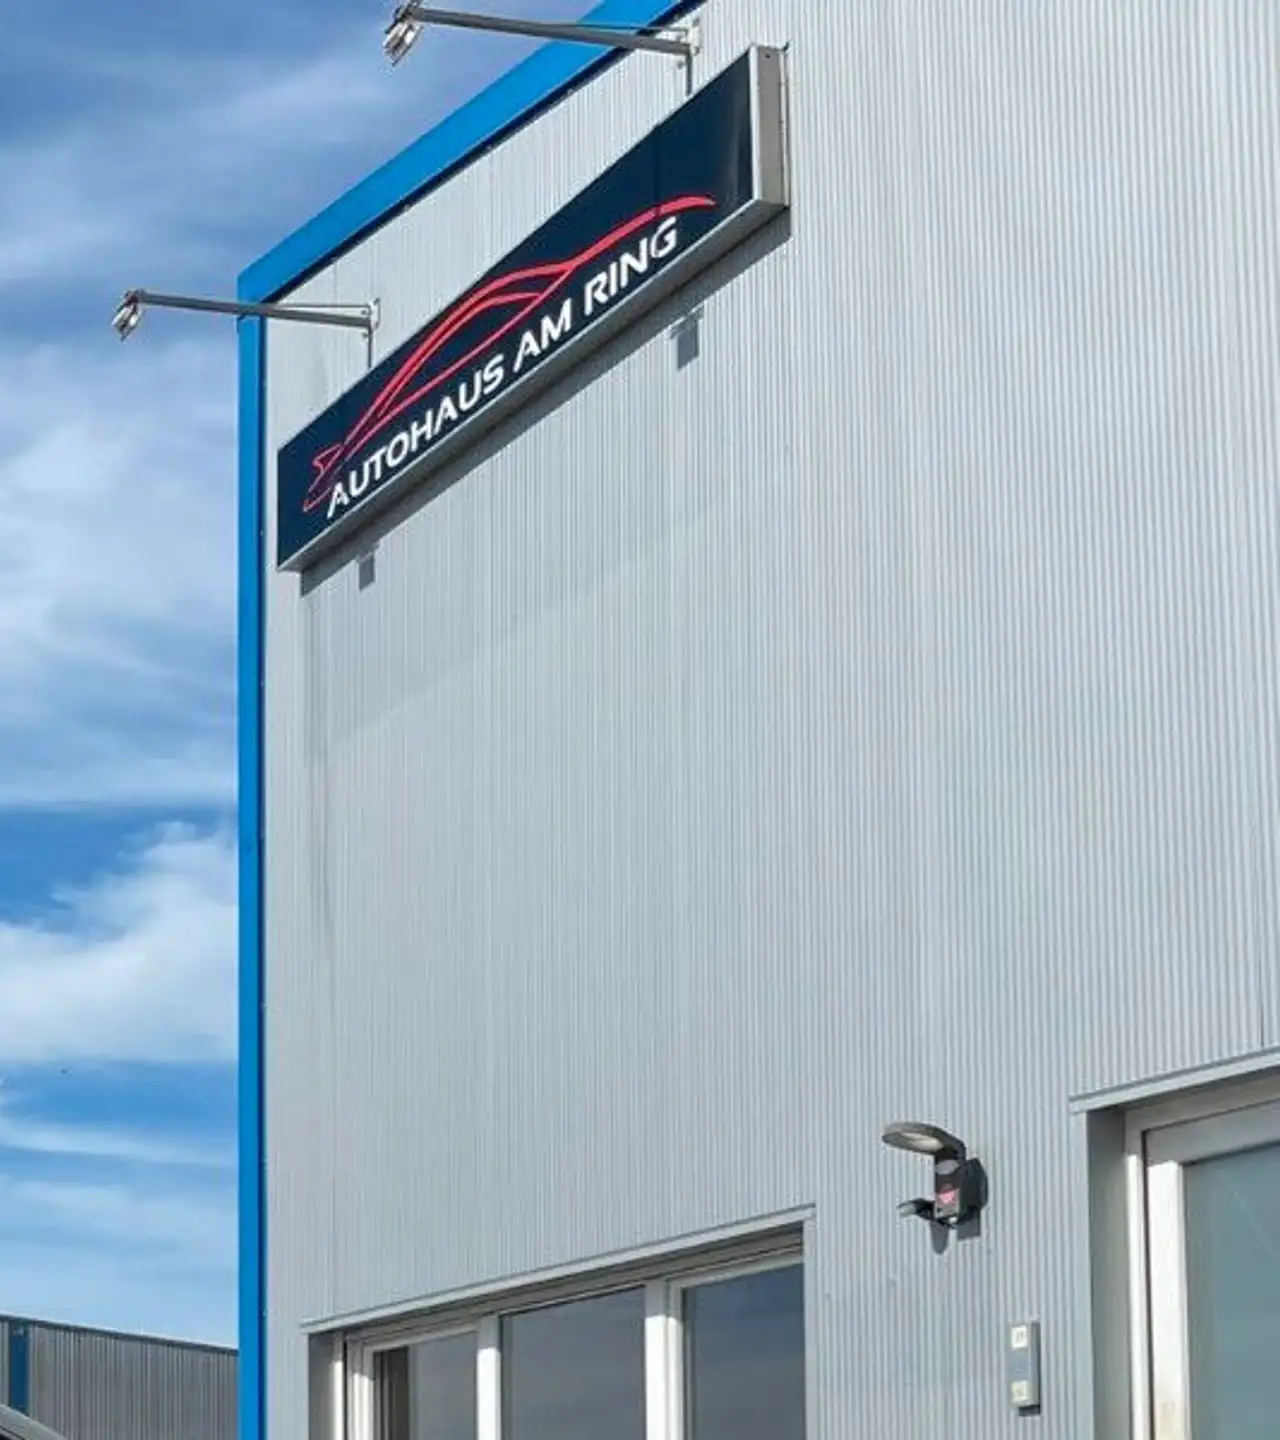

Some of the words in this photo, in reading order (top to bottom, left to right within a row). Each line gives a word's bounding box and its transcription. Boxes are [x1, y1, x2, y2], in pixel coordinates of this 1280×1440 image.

[327, 355, 504, 518] AUTOHAUS
[513, 299, 572, 373] AM
[584, 216, 680, 315] RING
